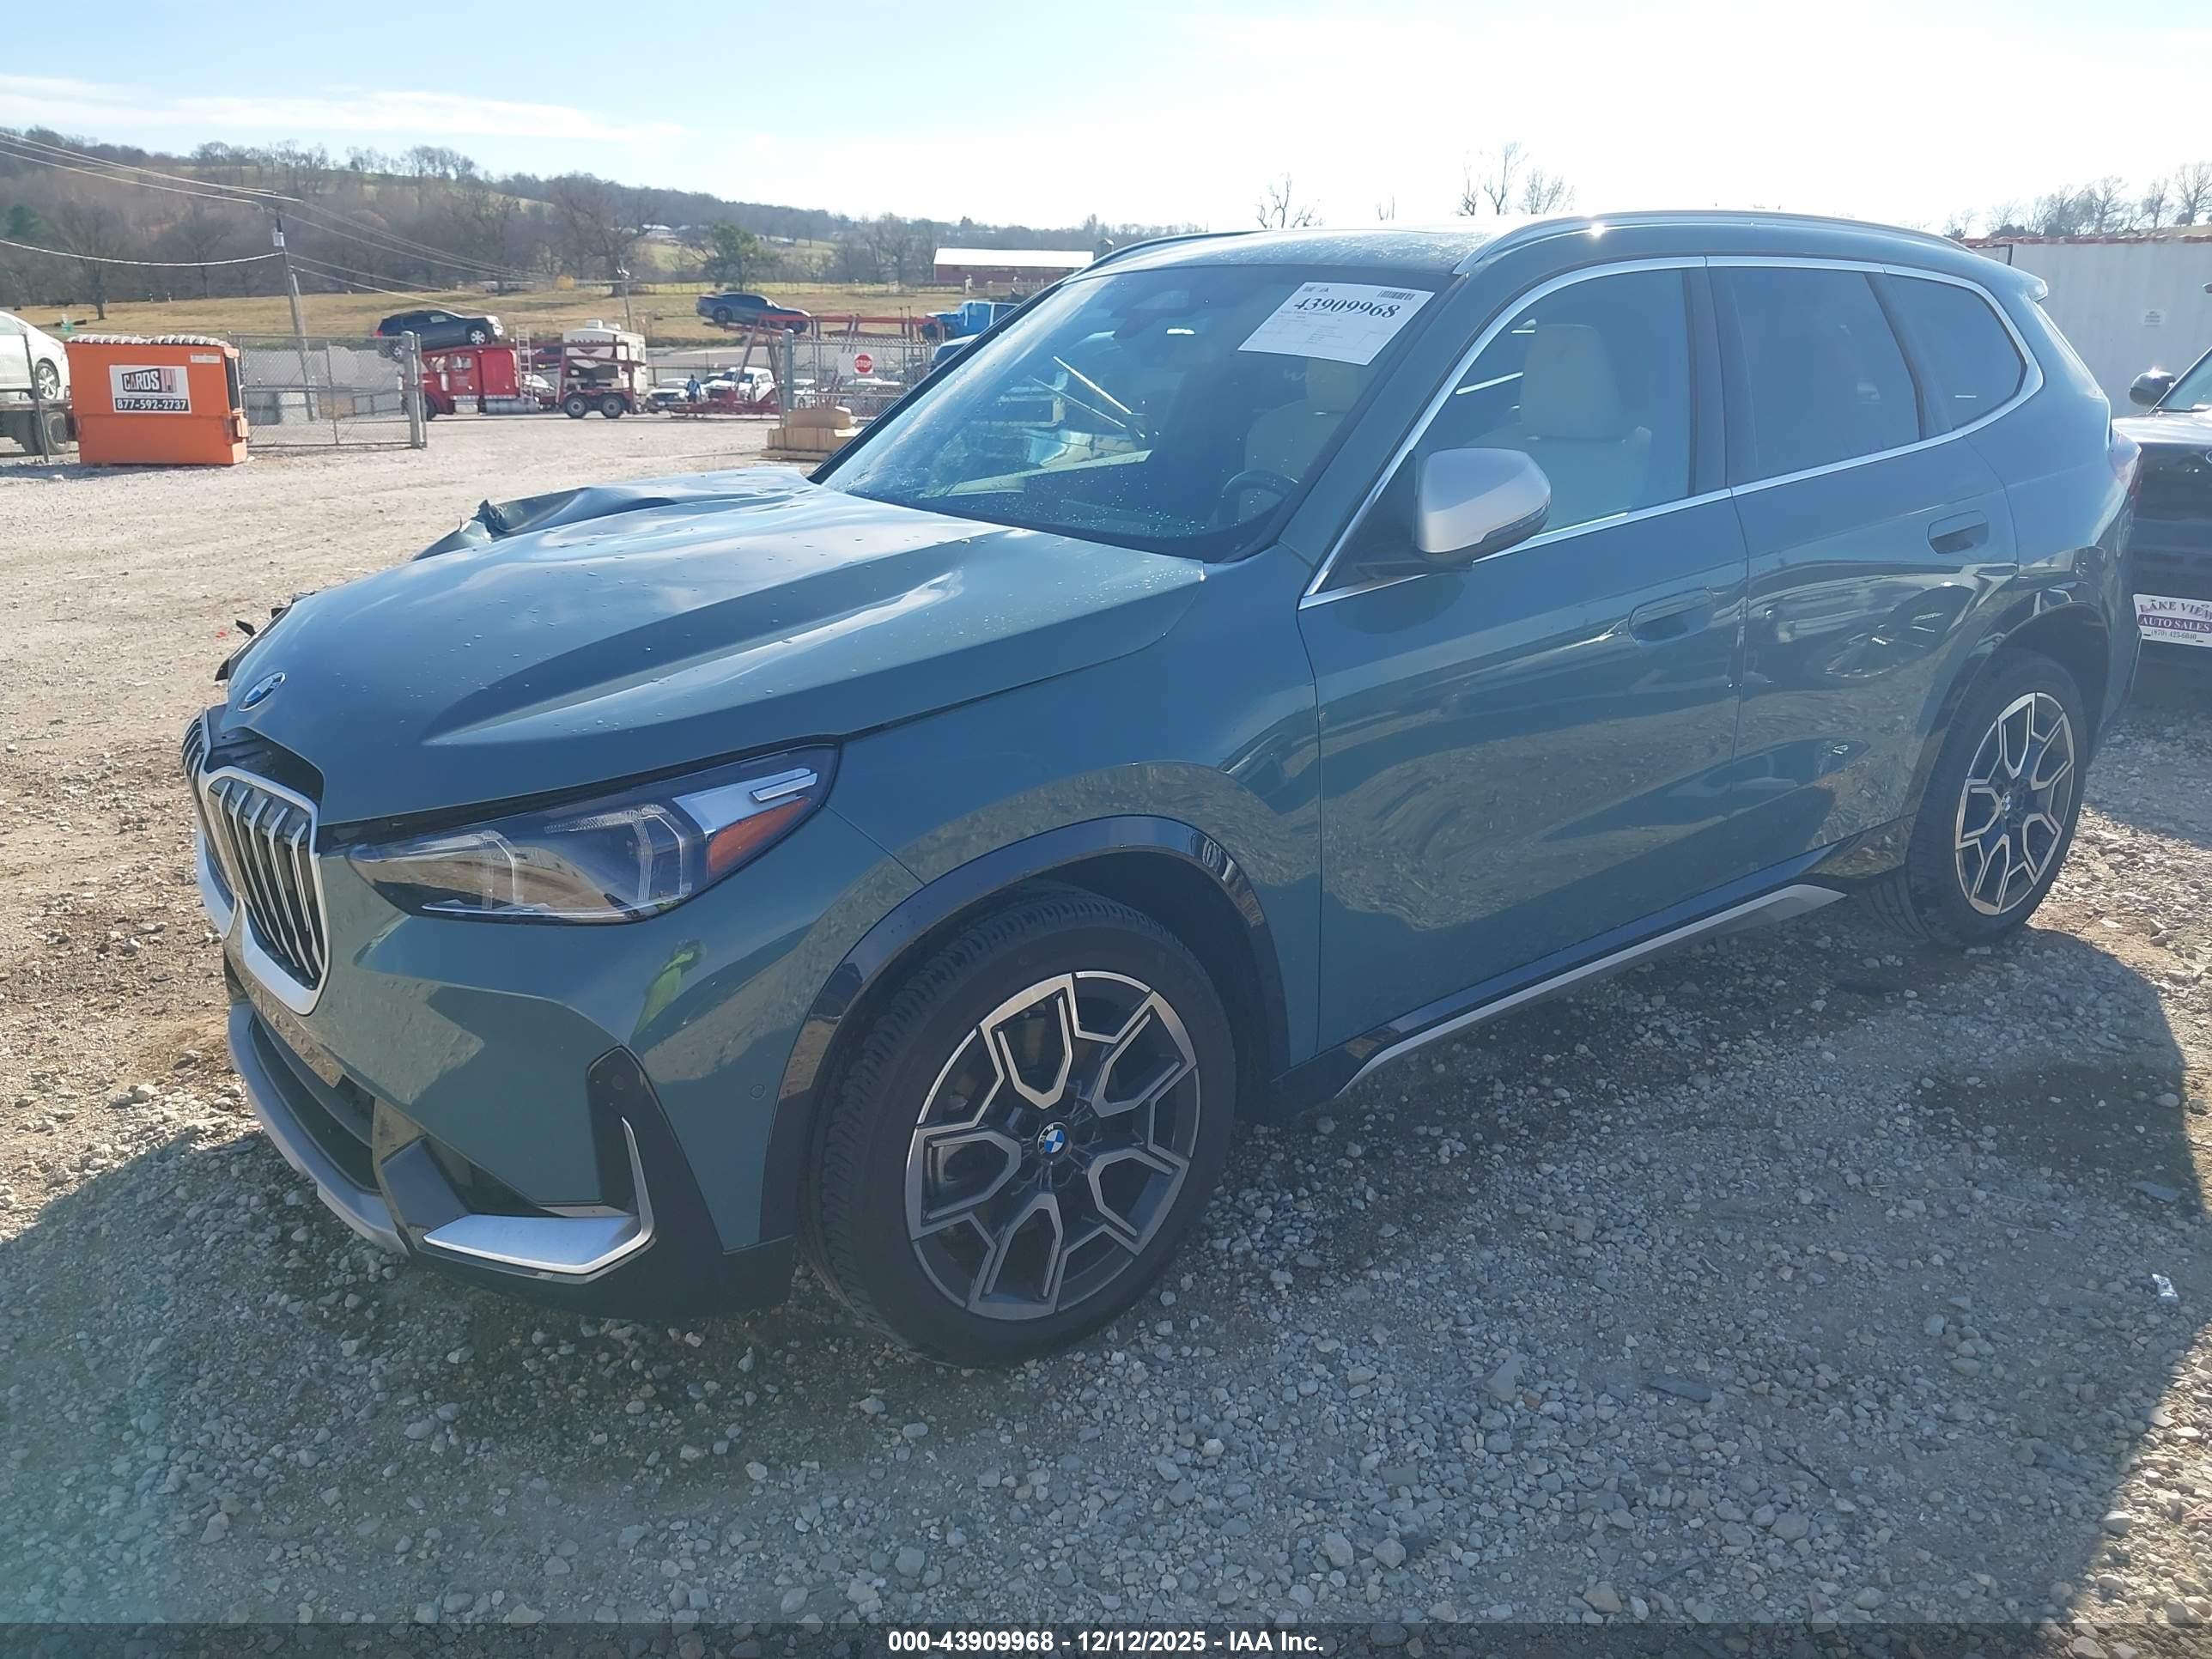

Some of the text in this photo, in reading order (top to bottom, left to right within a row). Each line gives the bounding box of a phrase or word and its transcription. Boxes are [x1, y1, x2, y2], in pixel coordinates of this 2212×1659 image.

[1293, 297, 1401, 319] 43909968
[855, 359, 872, 368] STOP
[124, 370, 160, 391] CARDS
[117, 398, 186, 410] 877-592-2737
[2139, 601, 2177, 613] LAKE
[2140, 617, 2209, 632] AUTO SALES
